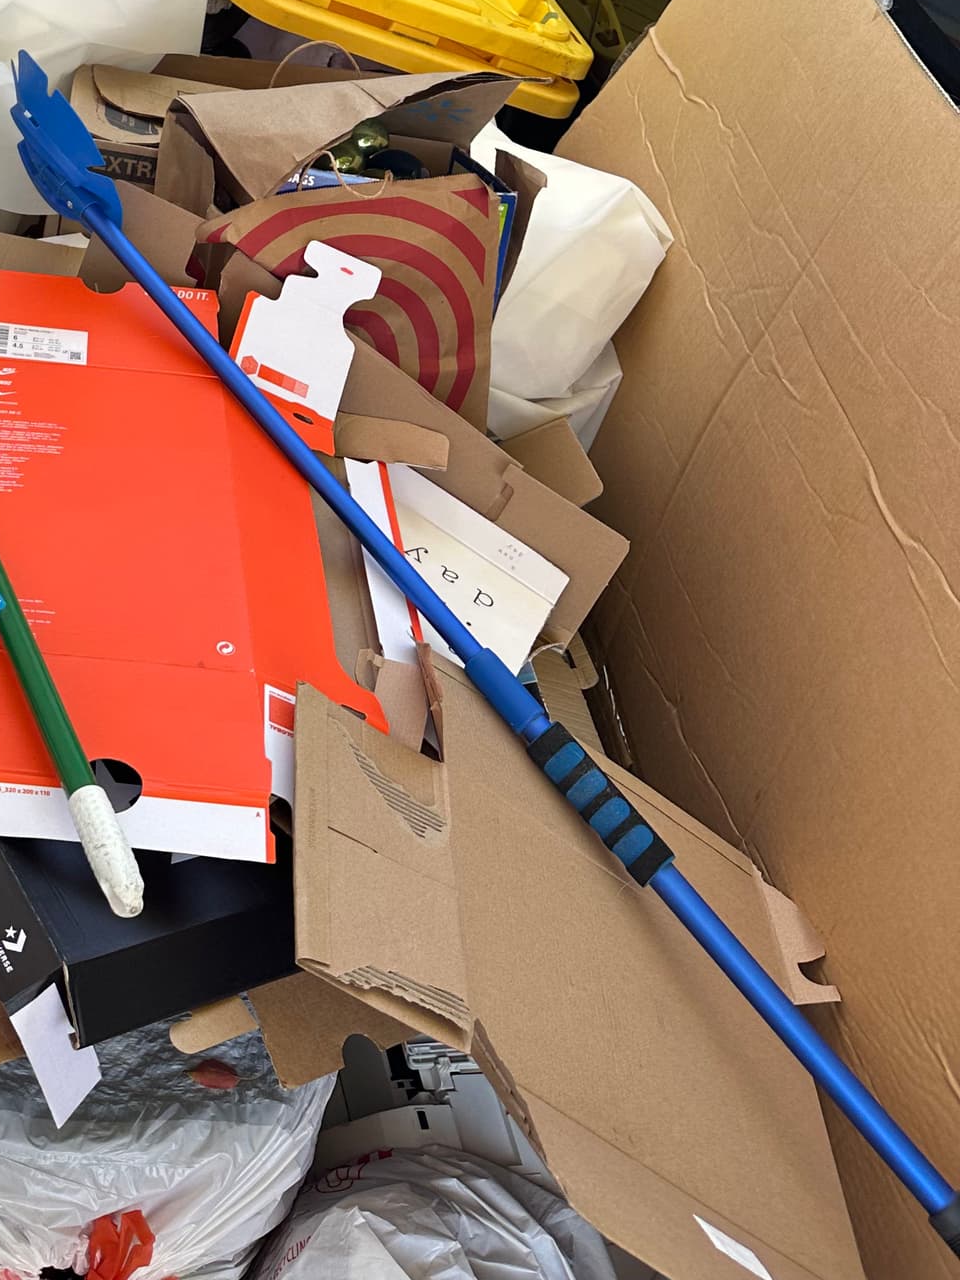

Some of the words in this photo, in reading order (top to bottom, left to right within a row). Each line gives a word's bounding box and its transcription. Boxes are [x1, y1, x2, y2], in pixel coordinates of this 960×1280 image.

[100, 154, 155, 180] EXTR
[176, 290, 193, 299] DO
[196, 291, 209, 300] IT.
